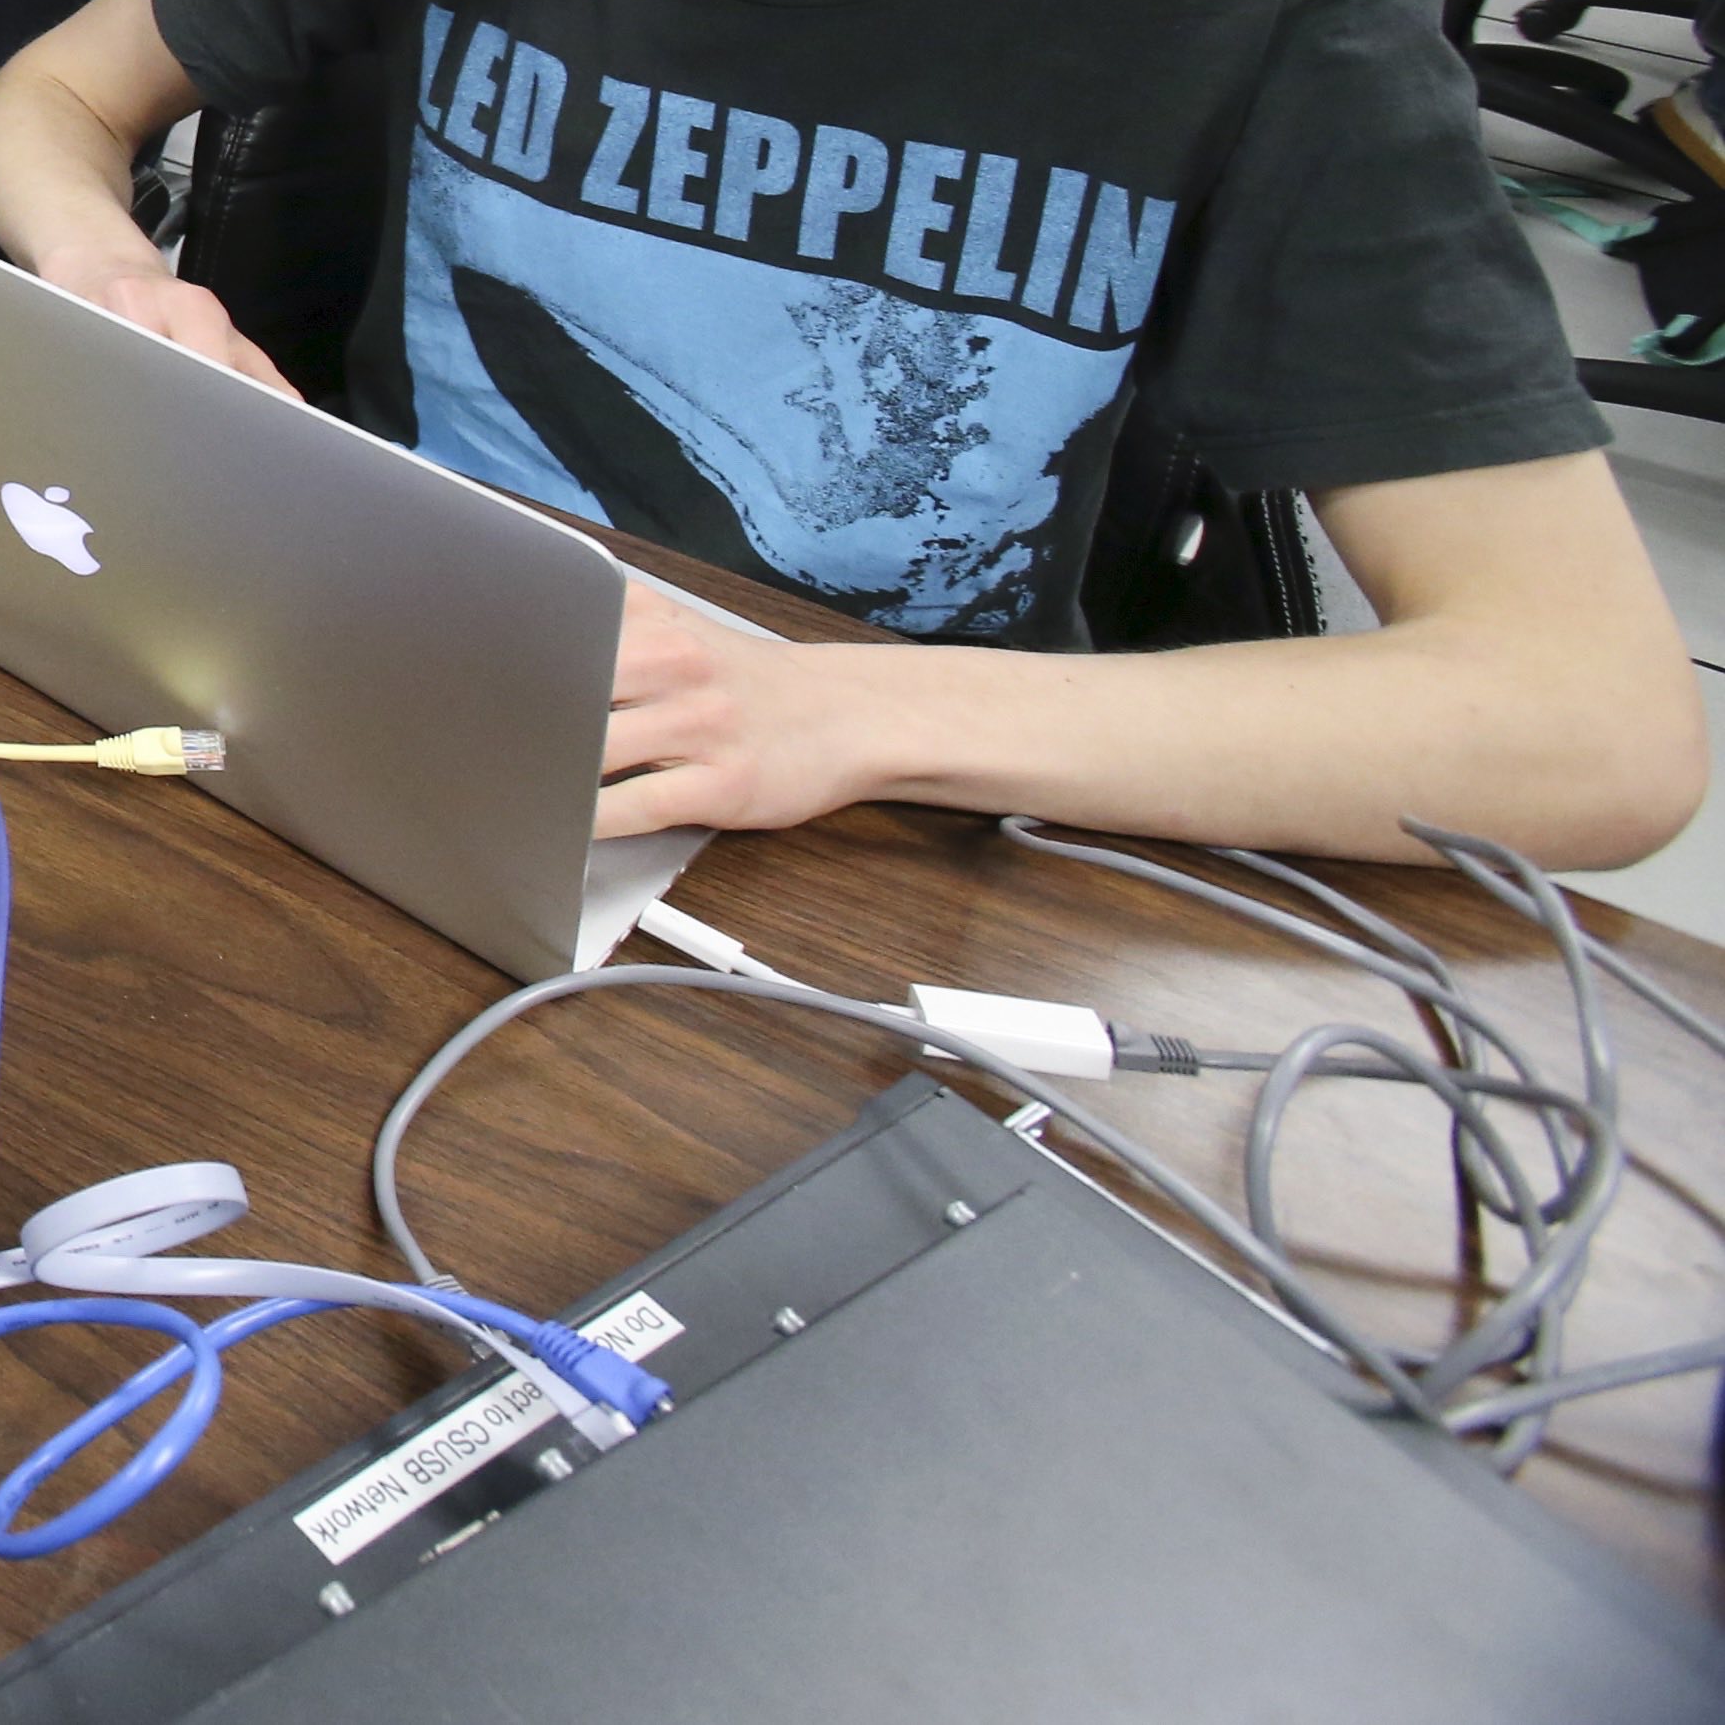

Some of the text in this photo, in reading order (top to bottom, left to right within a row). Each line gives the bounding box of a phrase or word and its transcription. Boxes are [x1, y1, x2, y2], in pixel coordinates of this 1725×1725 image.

[418, 2, 1179, 335] LED ZEPPELIN
[629, 1305, 666, 1335] Do
[309, 1401, 514, 1545] to CSUSB Network
